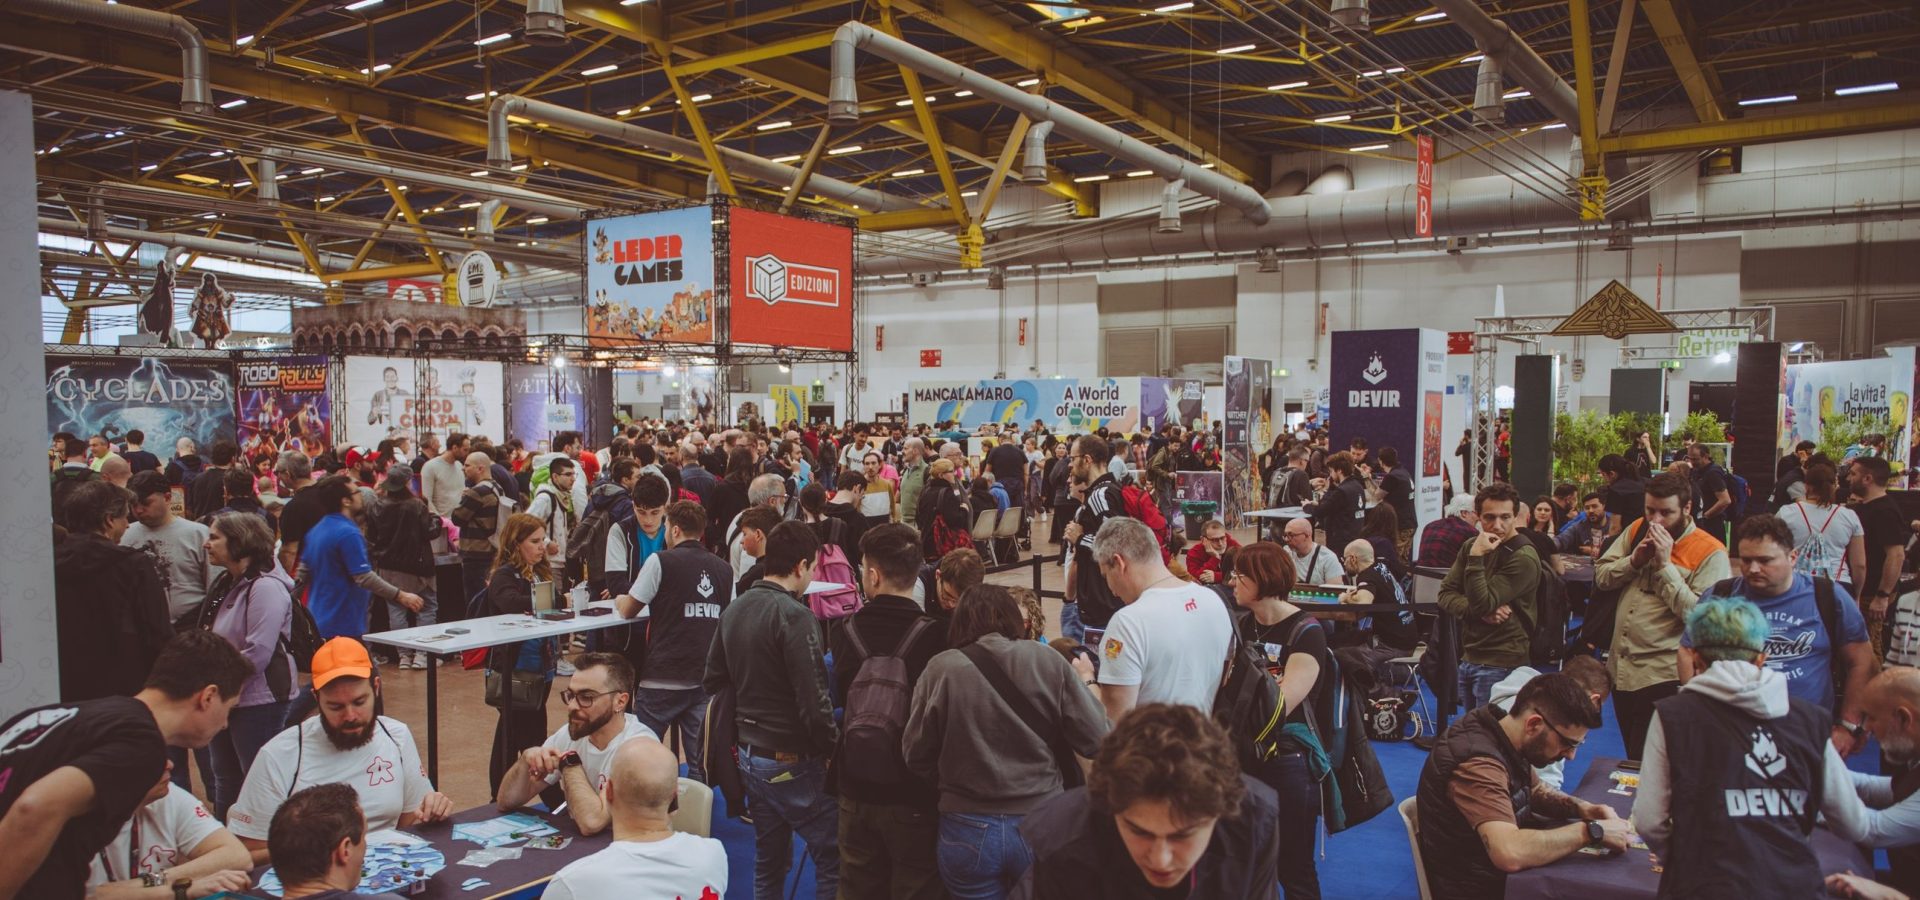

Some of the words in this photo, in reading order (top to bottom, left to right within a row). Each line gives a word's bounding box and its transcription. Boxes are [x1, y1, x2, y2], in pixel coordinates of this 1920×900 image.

[1420, 160, 1431, 186] 20
[1420, 195, 1429, 234] B
[613, 234, 683, 264] LEDER
[614, 259, 683, 286] GAMES
[790, 273, 833, 295] EDIZIONI
[54, 378, 226, 404] CYCLADES
[914, 387, 1014, 401] MANCALAMARO
[1064, 386, 1074, 401] A
[1079, 386, 1119, 401] World
[1348, 390, 1401, 408] DEVIR
[1849, 382, 1860, 402] La
[1861, 384, 1879, 403] vita
[1880, 384, 1887, 399] a
[404, 399, 453, 413] FOOD
[1056, 402, 1069, 416] of
[684, 602, 721, 619] DEVIR
